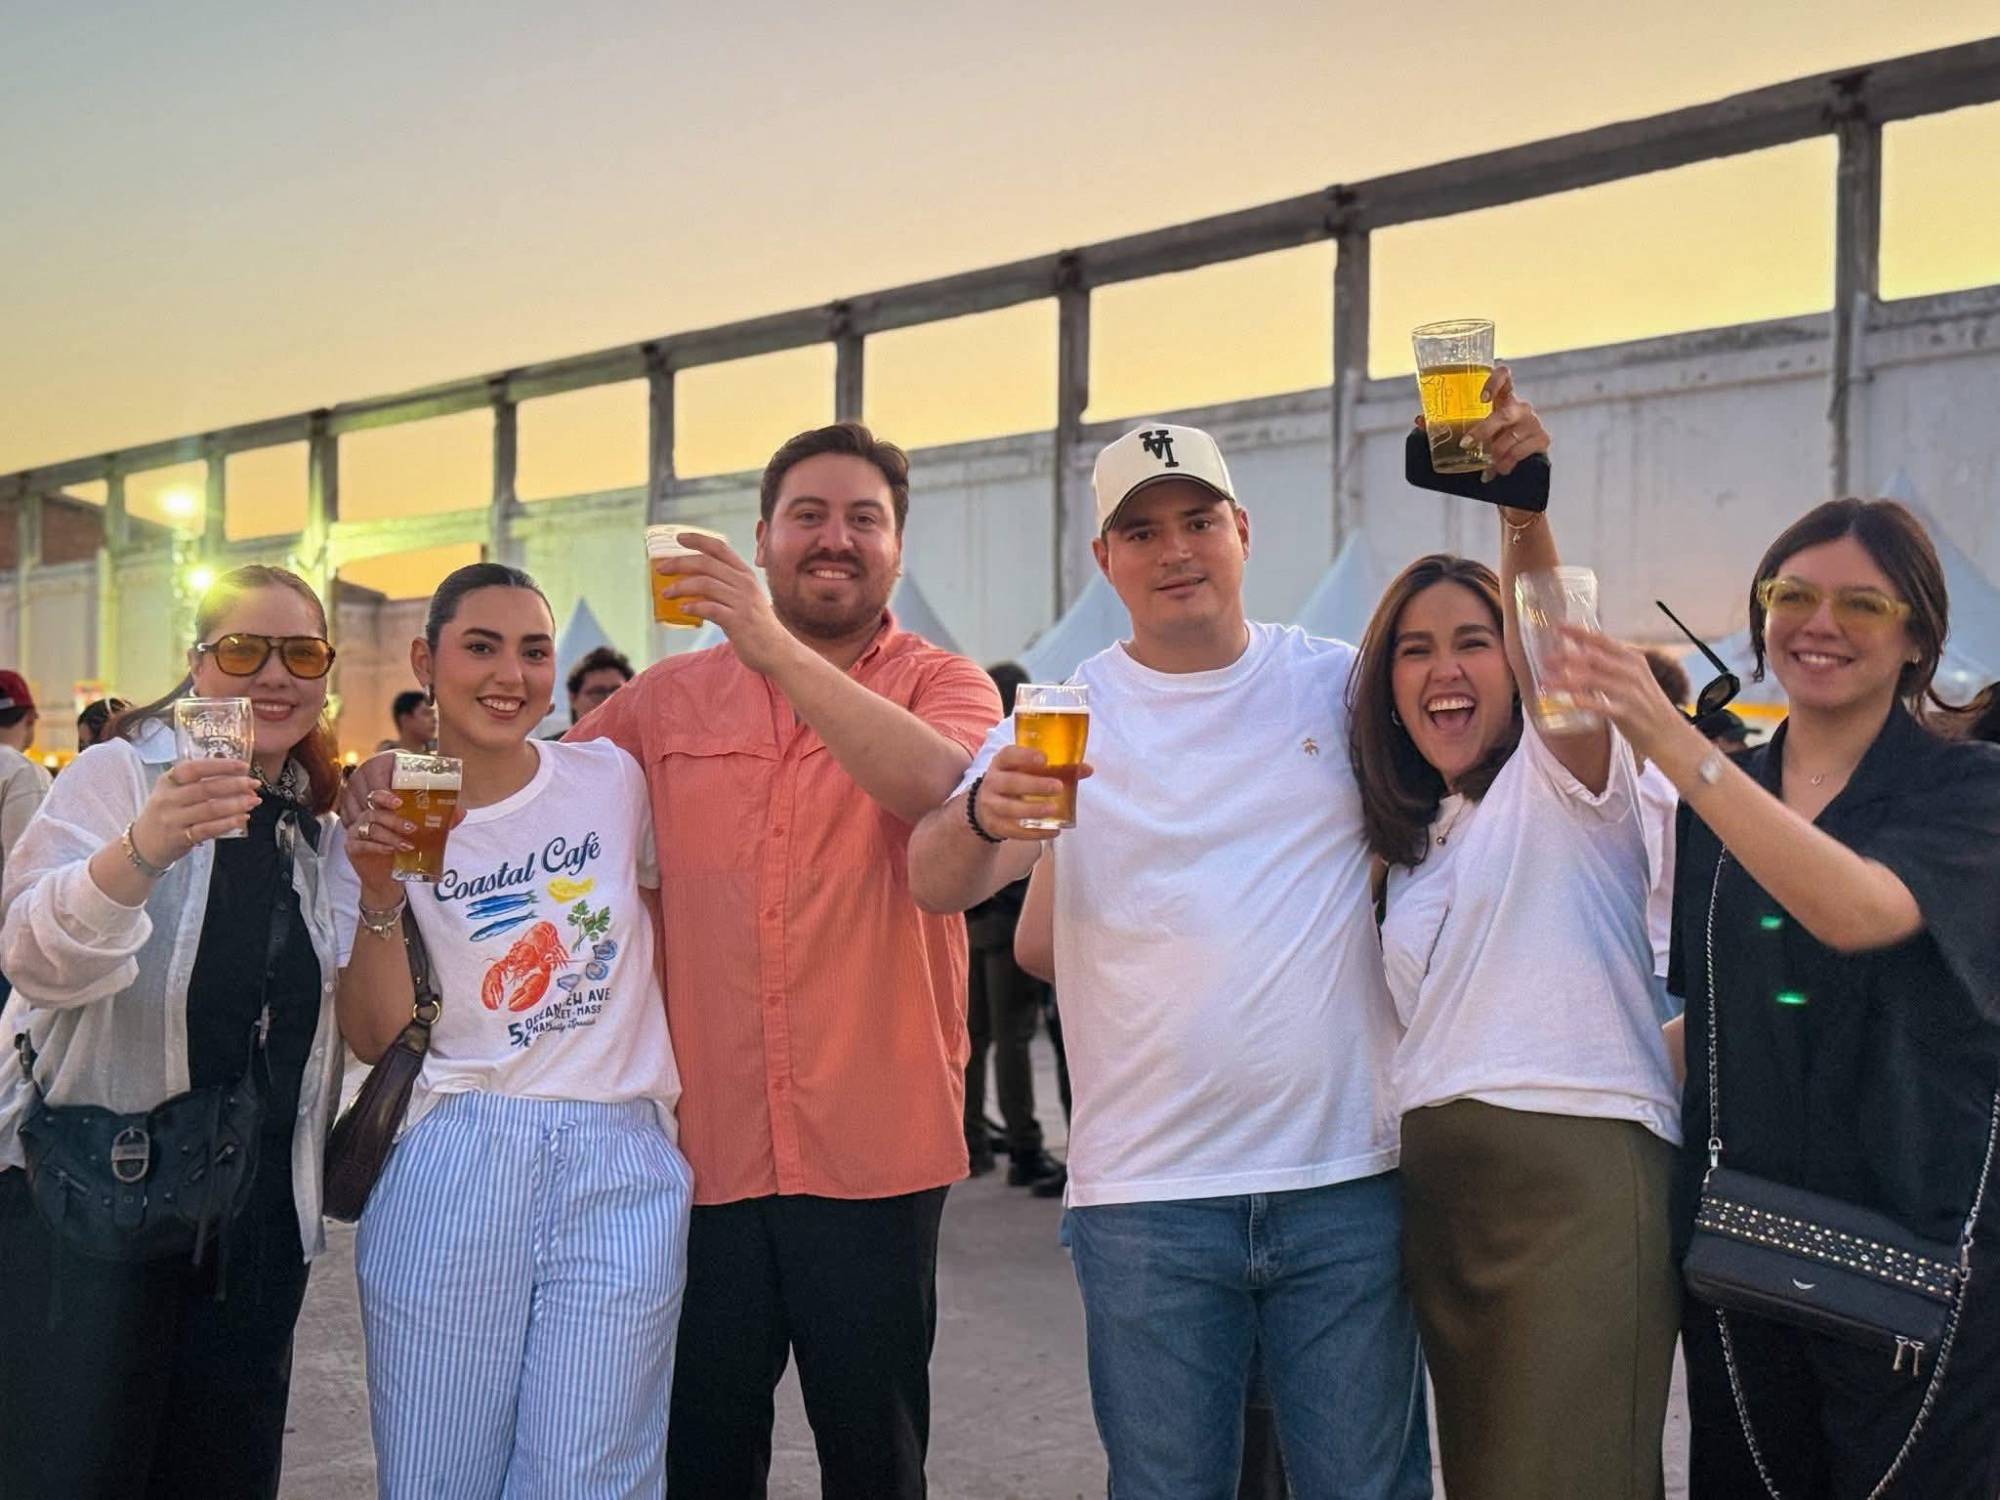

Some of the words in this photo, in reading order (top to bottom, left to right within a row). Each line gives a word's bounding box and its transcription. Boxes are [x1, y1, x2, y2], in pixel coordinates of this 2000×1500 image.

[433, 853, 536, 902] Coastal
[541, 831, 601, 876] Café
[588, 987, 612, 1002] AVE
[577, 1004, 603, 1017] MASS
